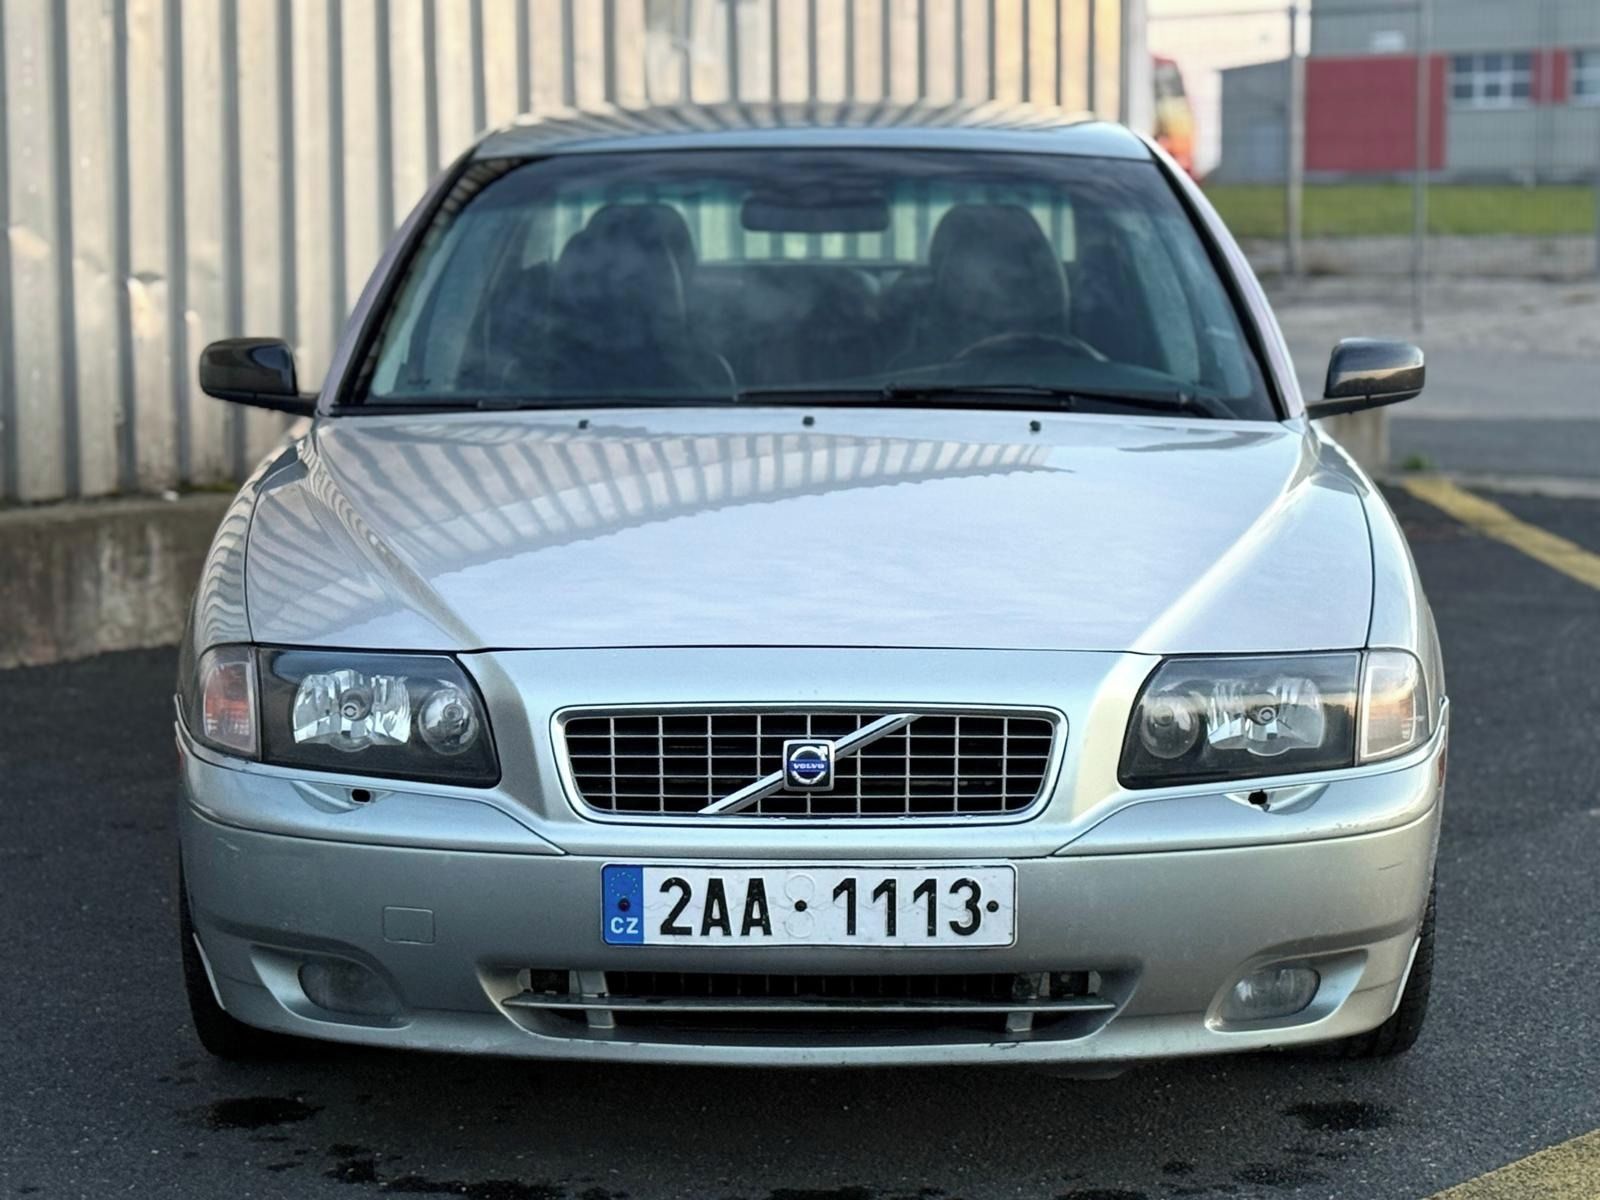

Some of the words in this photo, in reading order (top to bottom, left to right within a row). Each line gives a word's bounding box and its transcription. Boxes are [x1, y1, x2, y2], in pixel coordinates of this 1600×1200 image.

[793, 762, 825, 770] VOLVO
[659, 877, 773, 937] 2AA
[832, 877, 983, 937] 1113
[610, 916, 639, 935] CZ
